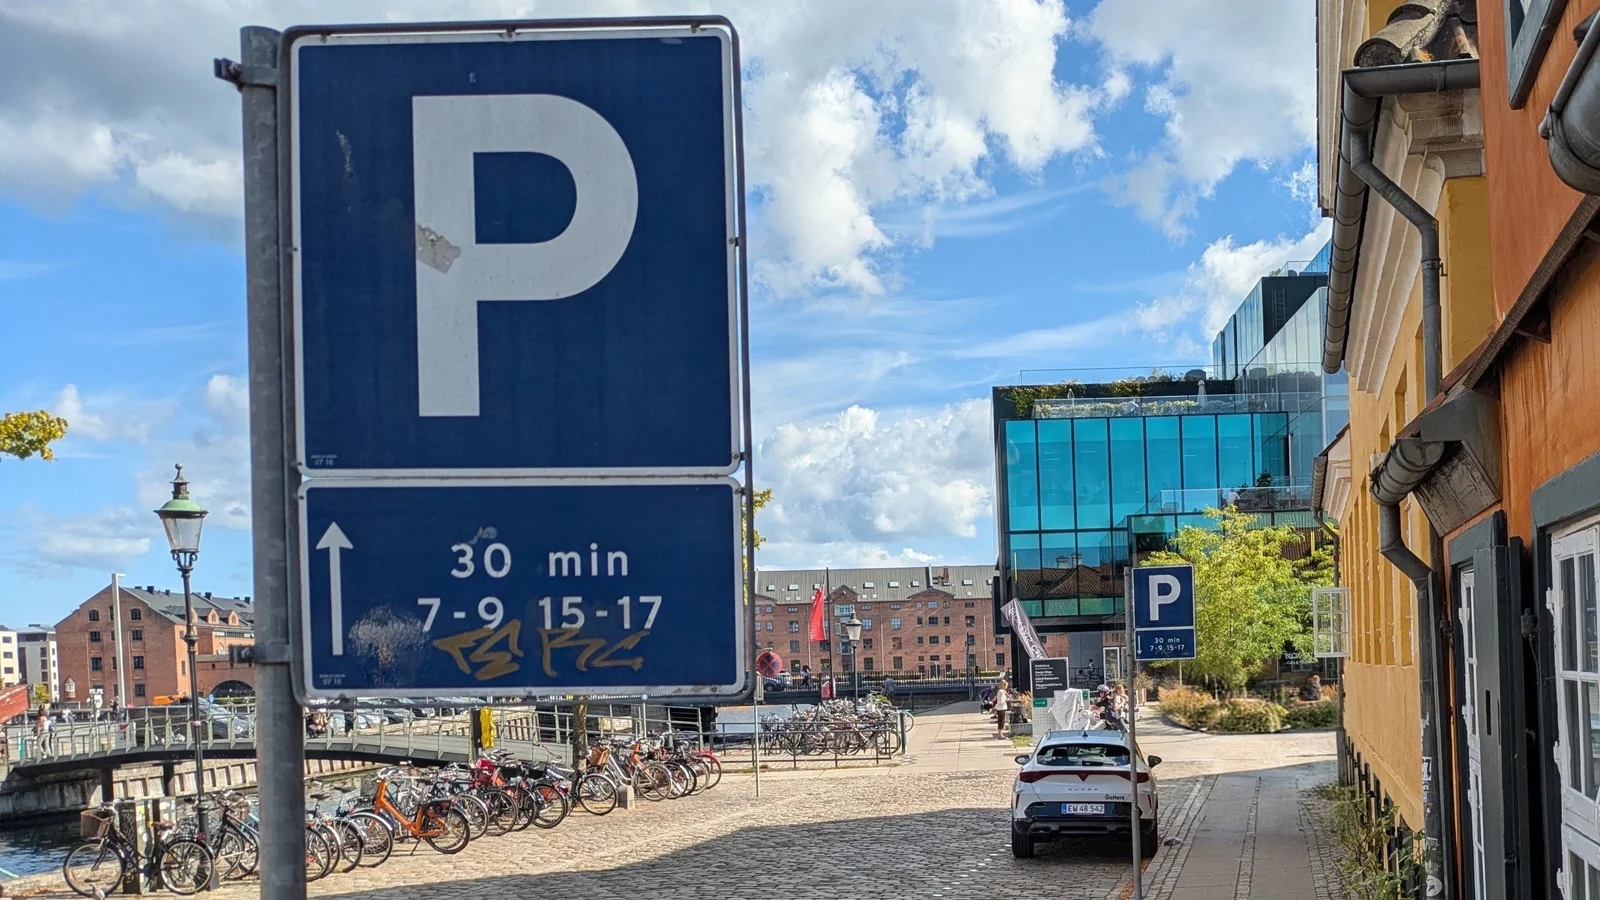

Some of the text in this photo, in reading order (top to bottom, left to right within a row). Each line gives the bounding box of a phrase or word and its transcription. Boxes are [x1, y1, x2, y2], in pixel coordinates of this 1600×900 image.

[412, 93, 639, 417] P
[450, 543, 629, 579] 30 min
[417, 595, 663, 632] 7-9 15-17
[1149, 574, 1181, 621] P
